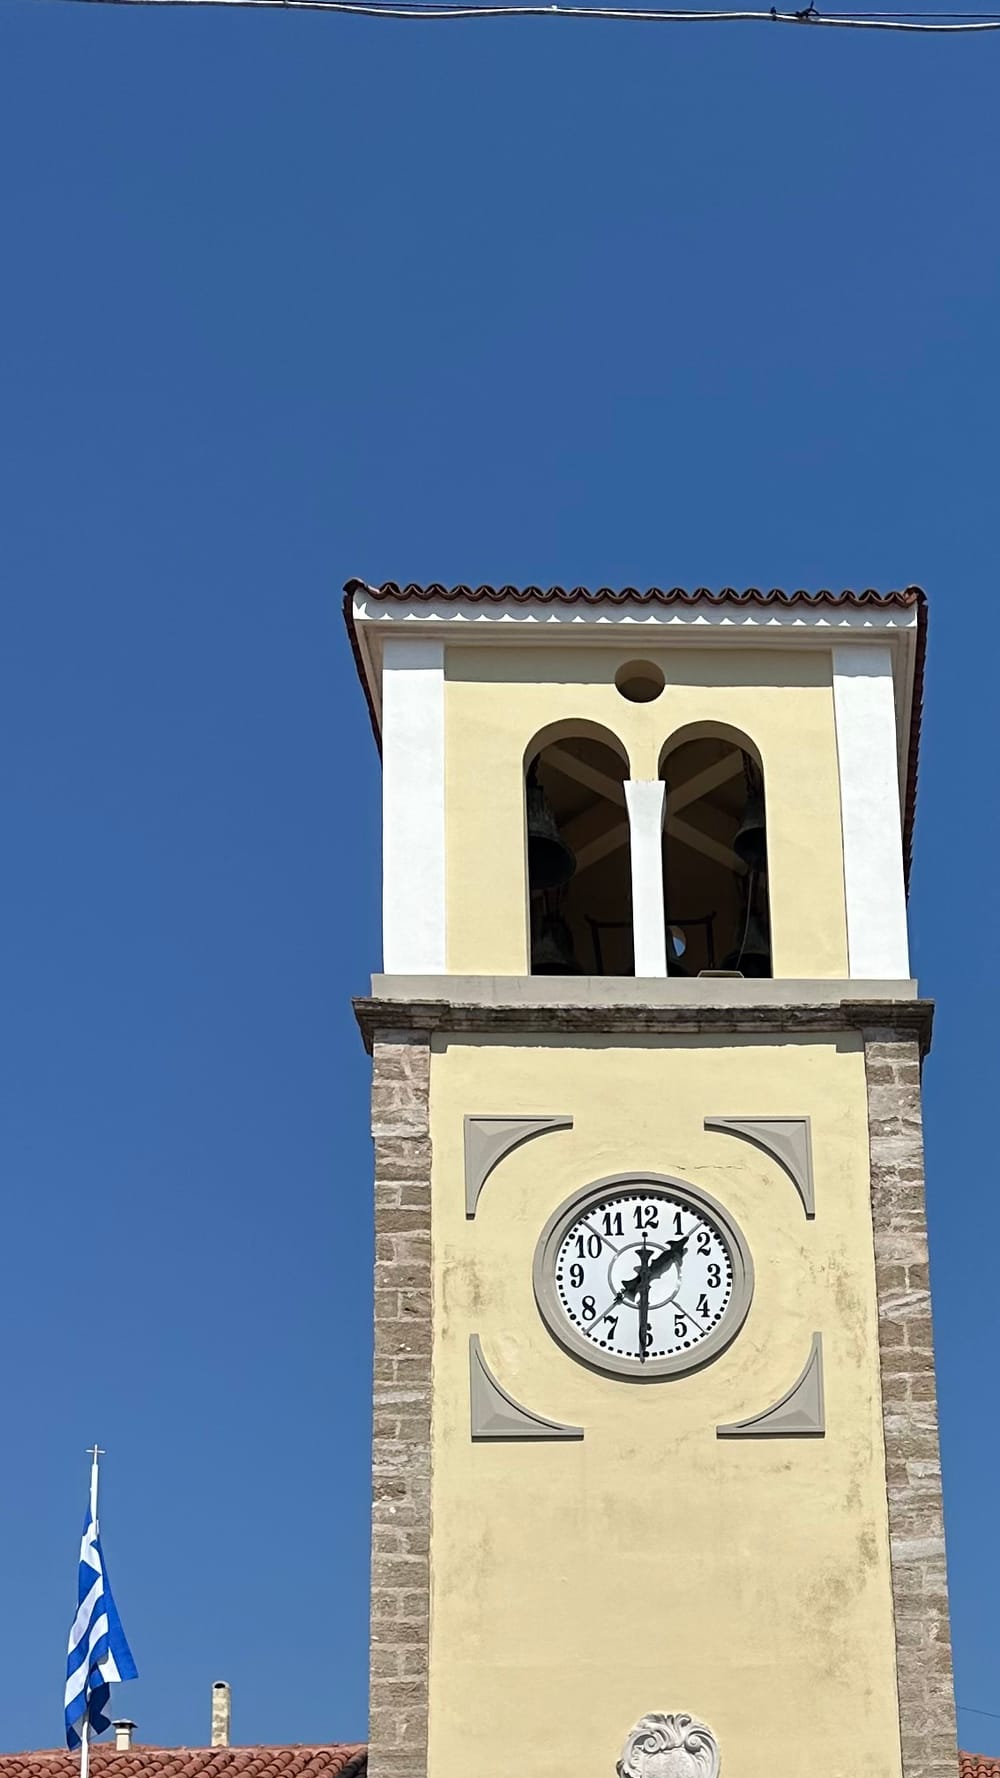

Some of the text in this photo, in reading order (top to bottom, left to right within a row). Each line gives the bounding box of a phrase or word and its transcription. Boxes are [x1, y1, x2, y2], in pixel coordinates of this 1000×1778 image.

[602, 1212, 624, 1236] 11
[633, 1205, 659, 1229] 12
[673, 1212, 684, 1235] 1
[575, 1234, 602, 1258] 10
[697, 1232, 712, 1256] 2
[569, 1264, 584, 1288] 9
[707, 1264, 721, 1288] 3
[581, 1296, 596, 1320] 8
[696, 1294, 710, 1317] 4
[603, 1315, 618, 1340] 7
[674, 1314, 687, 1337] 5
